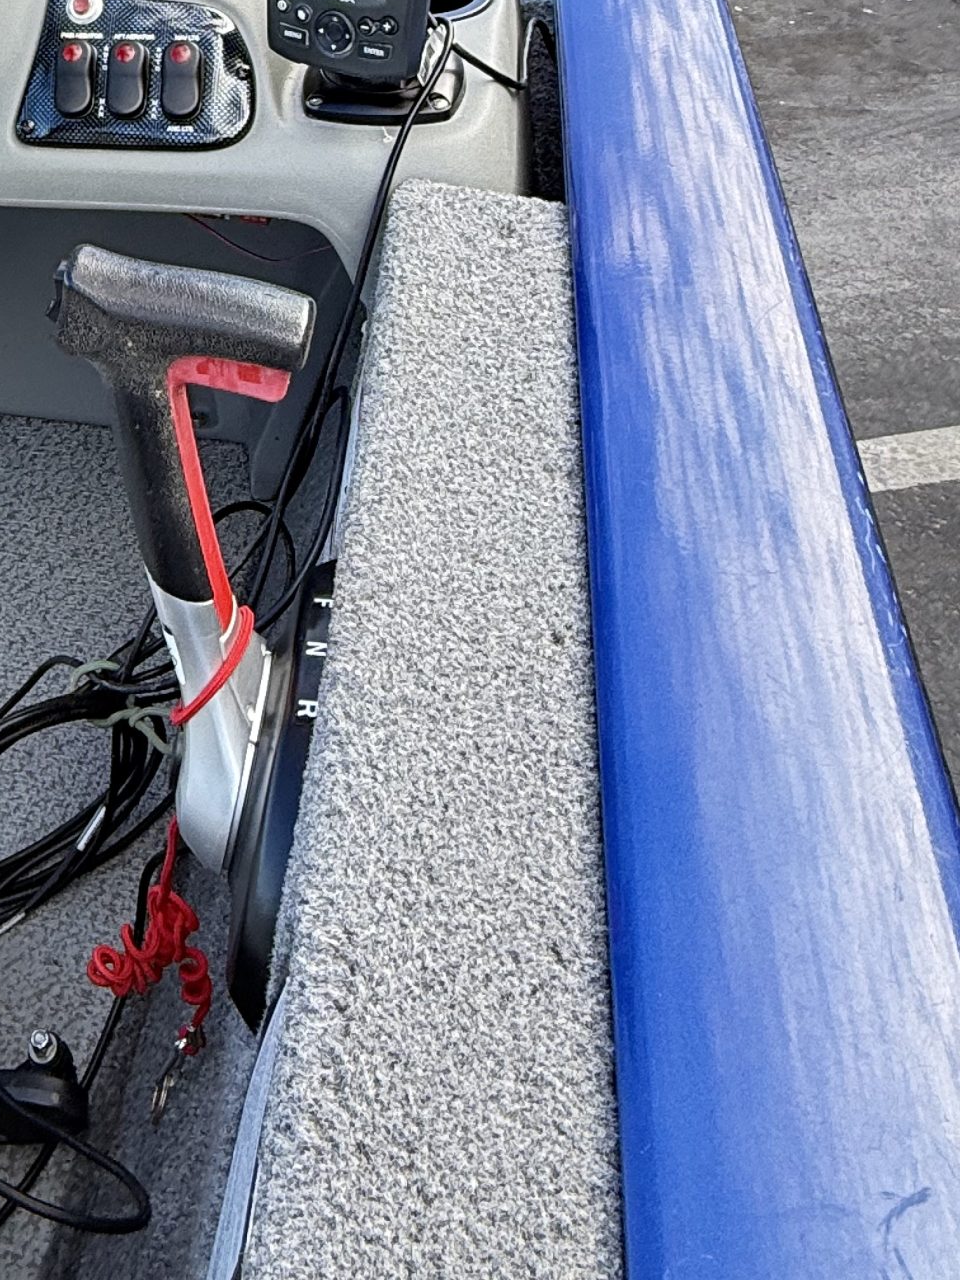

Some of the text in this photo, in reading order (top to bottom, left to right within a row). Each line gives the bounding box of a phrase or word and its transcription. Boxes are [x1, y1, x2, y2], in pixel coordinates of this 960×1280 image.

[297, 597, 335, 718] F N R
